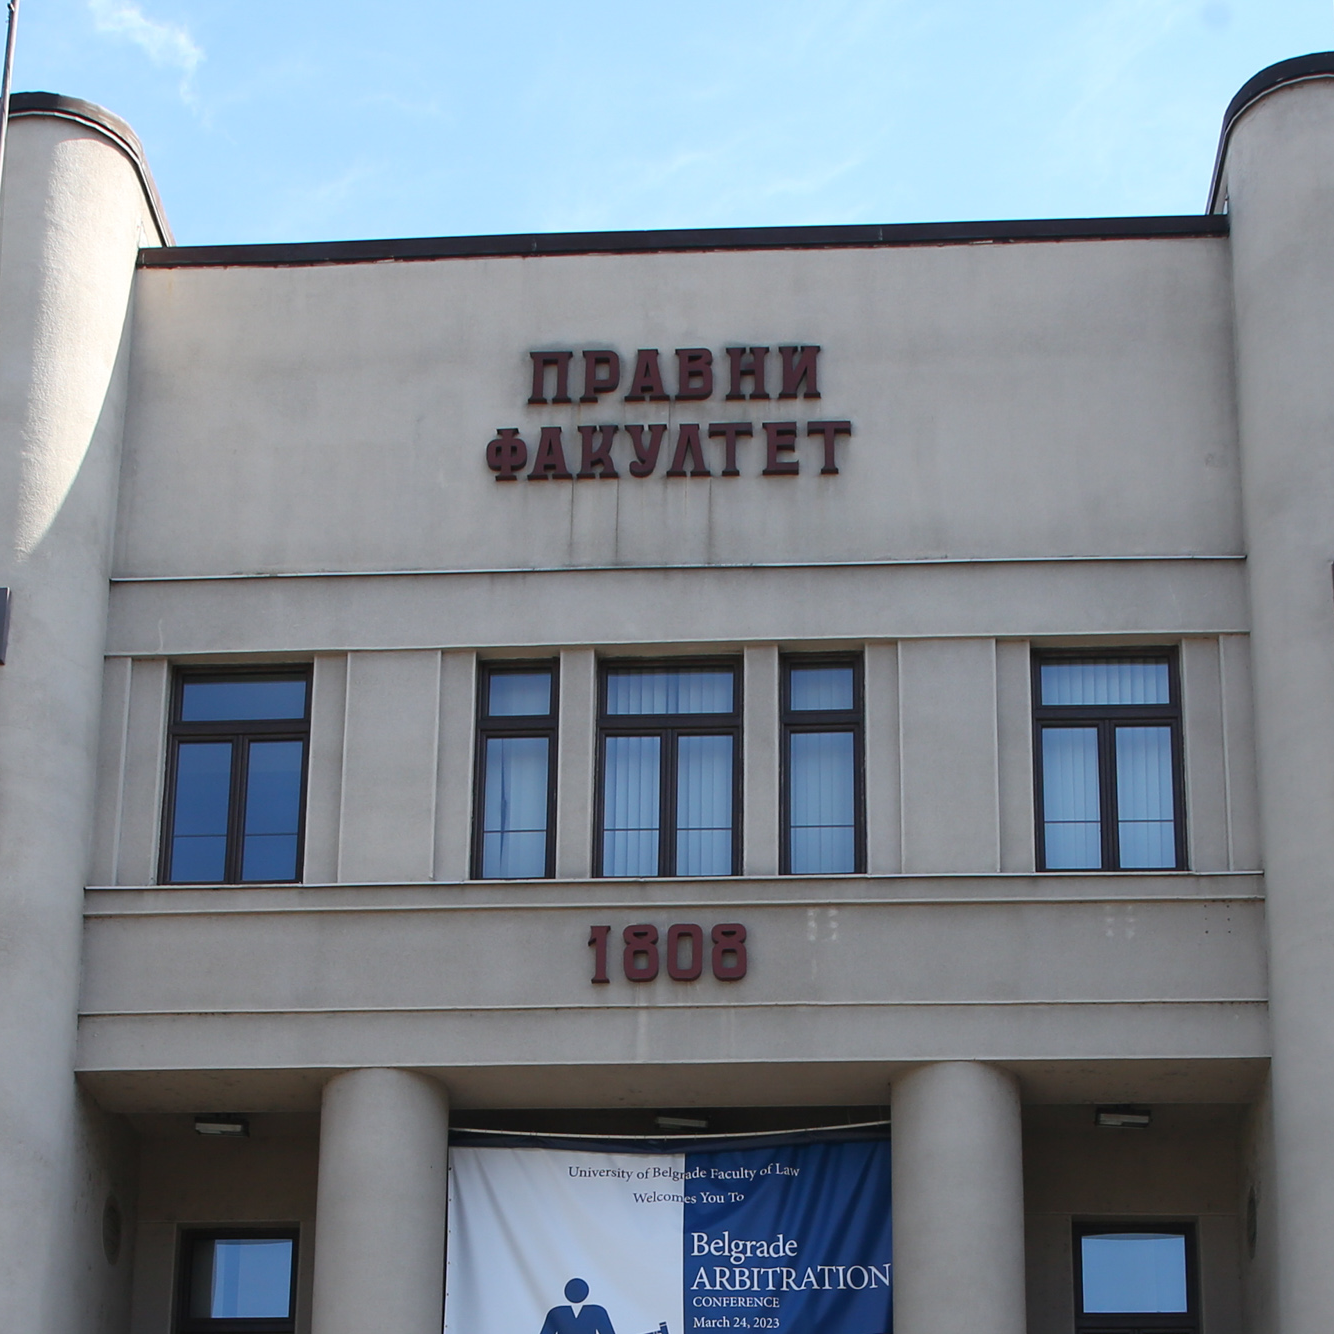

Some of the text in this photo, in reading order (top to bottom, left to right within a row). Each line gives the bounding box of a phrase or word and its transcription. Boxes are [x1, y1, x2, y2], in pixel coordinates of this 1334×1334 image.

[527, 345, 822, 405] ПРАВНИ
[485, 420, 852, 482] ФАКУЛТЕТ
[587, 923, 748, 984] 1808
[568, 1163, 800, 1182] University of Belgrade Faculty of Law
[633, 1191, 744, 1204] Welcomes You To
[690, 1231, 798, 1265] Belgrade
[690, 1263, 891, 1291] ARBITRATION
[692, 1296, 780, 1308] CONFERENCE
[693, 1316, 780, 1329] March 24, 2023
